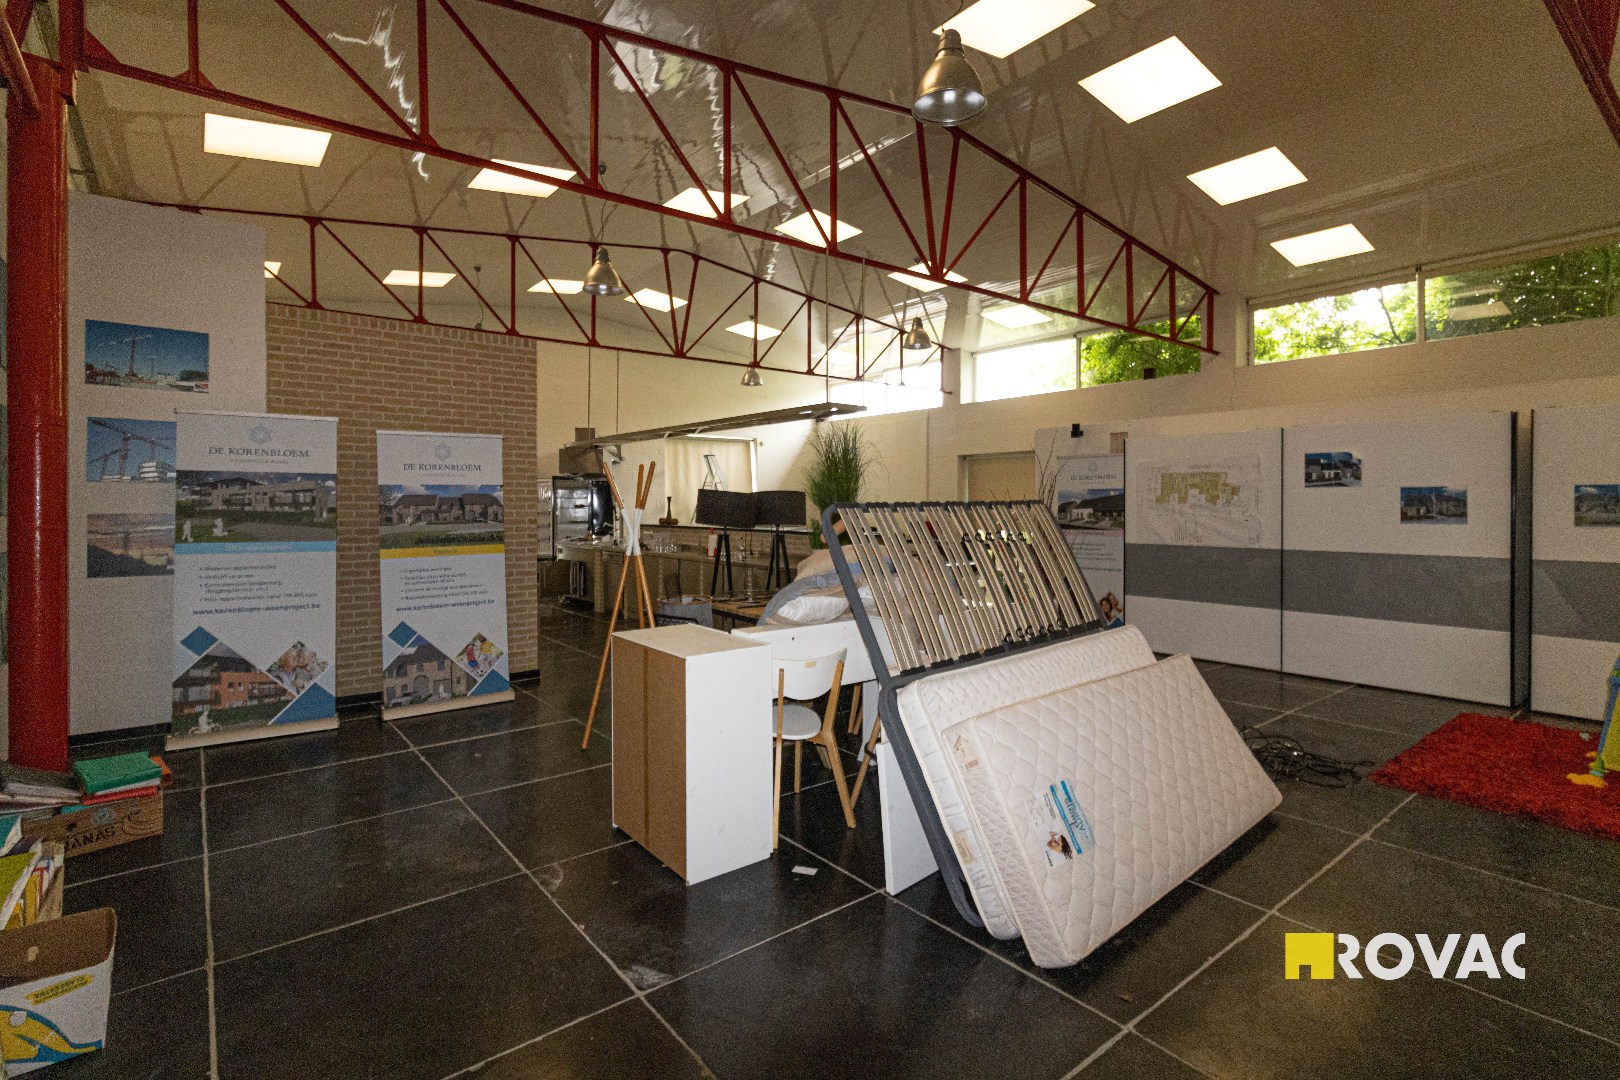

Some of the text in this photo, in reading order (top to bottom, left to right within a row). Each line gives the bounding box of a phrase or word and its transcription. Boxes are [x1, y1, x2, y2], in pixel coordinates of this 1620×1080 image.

[208, 446, 310, 458] DE KORENBLOEM
[403, 463, 482, 472] DE KORENBLOEM
